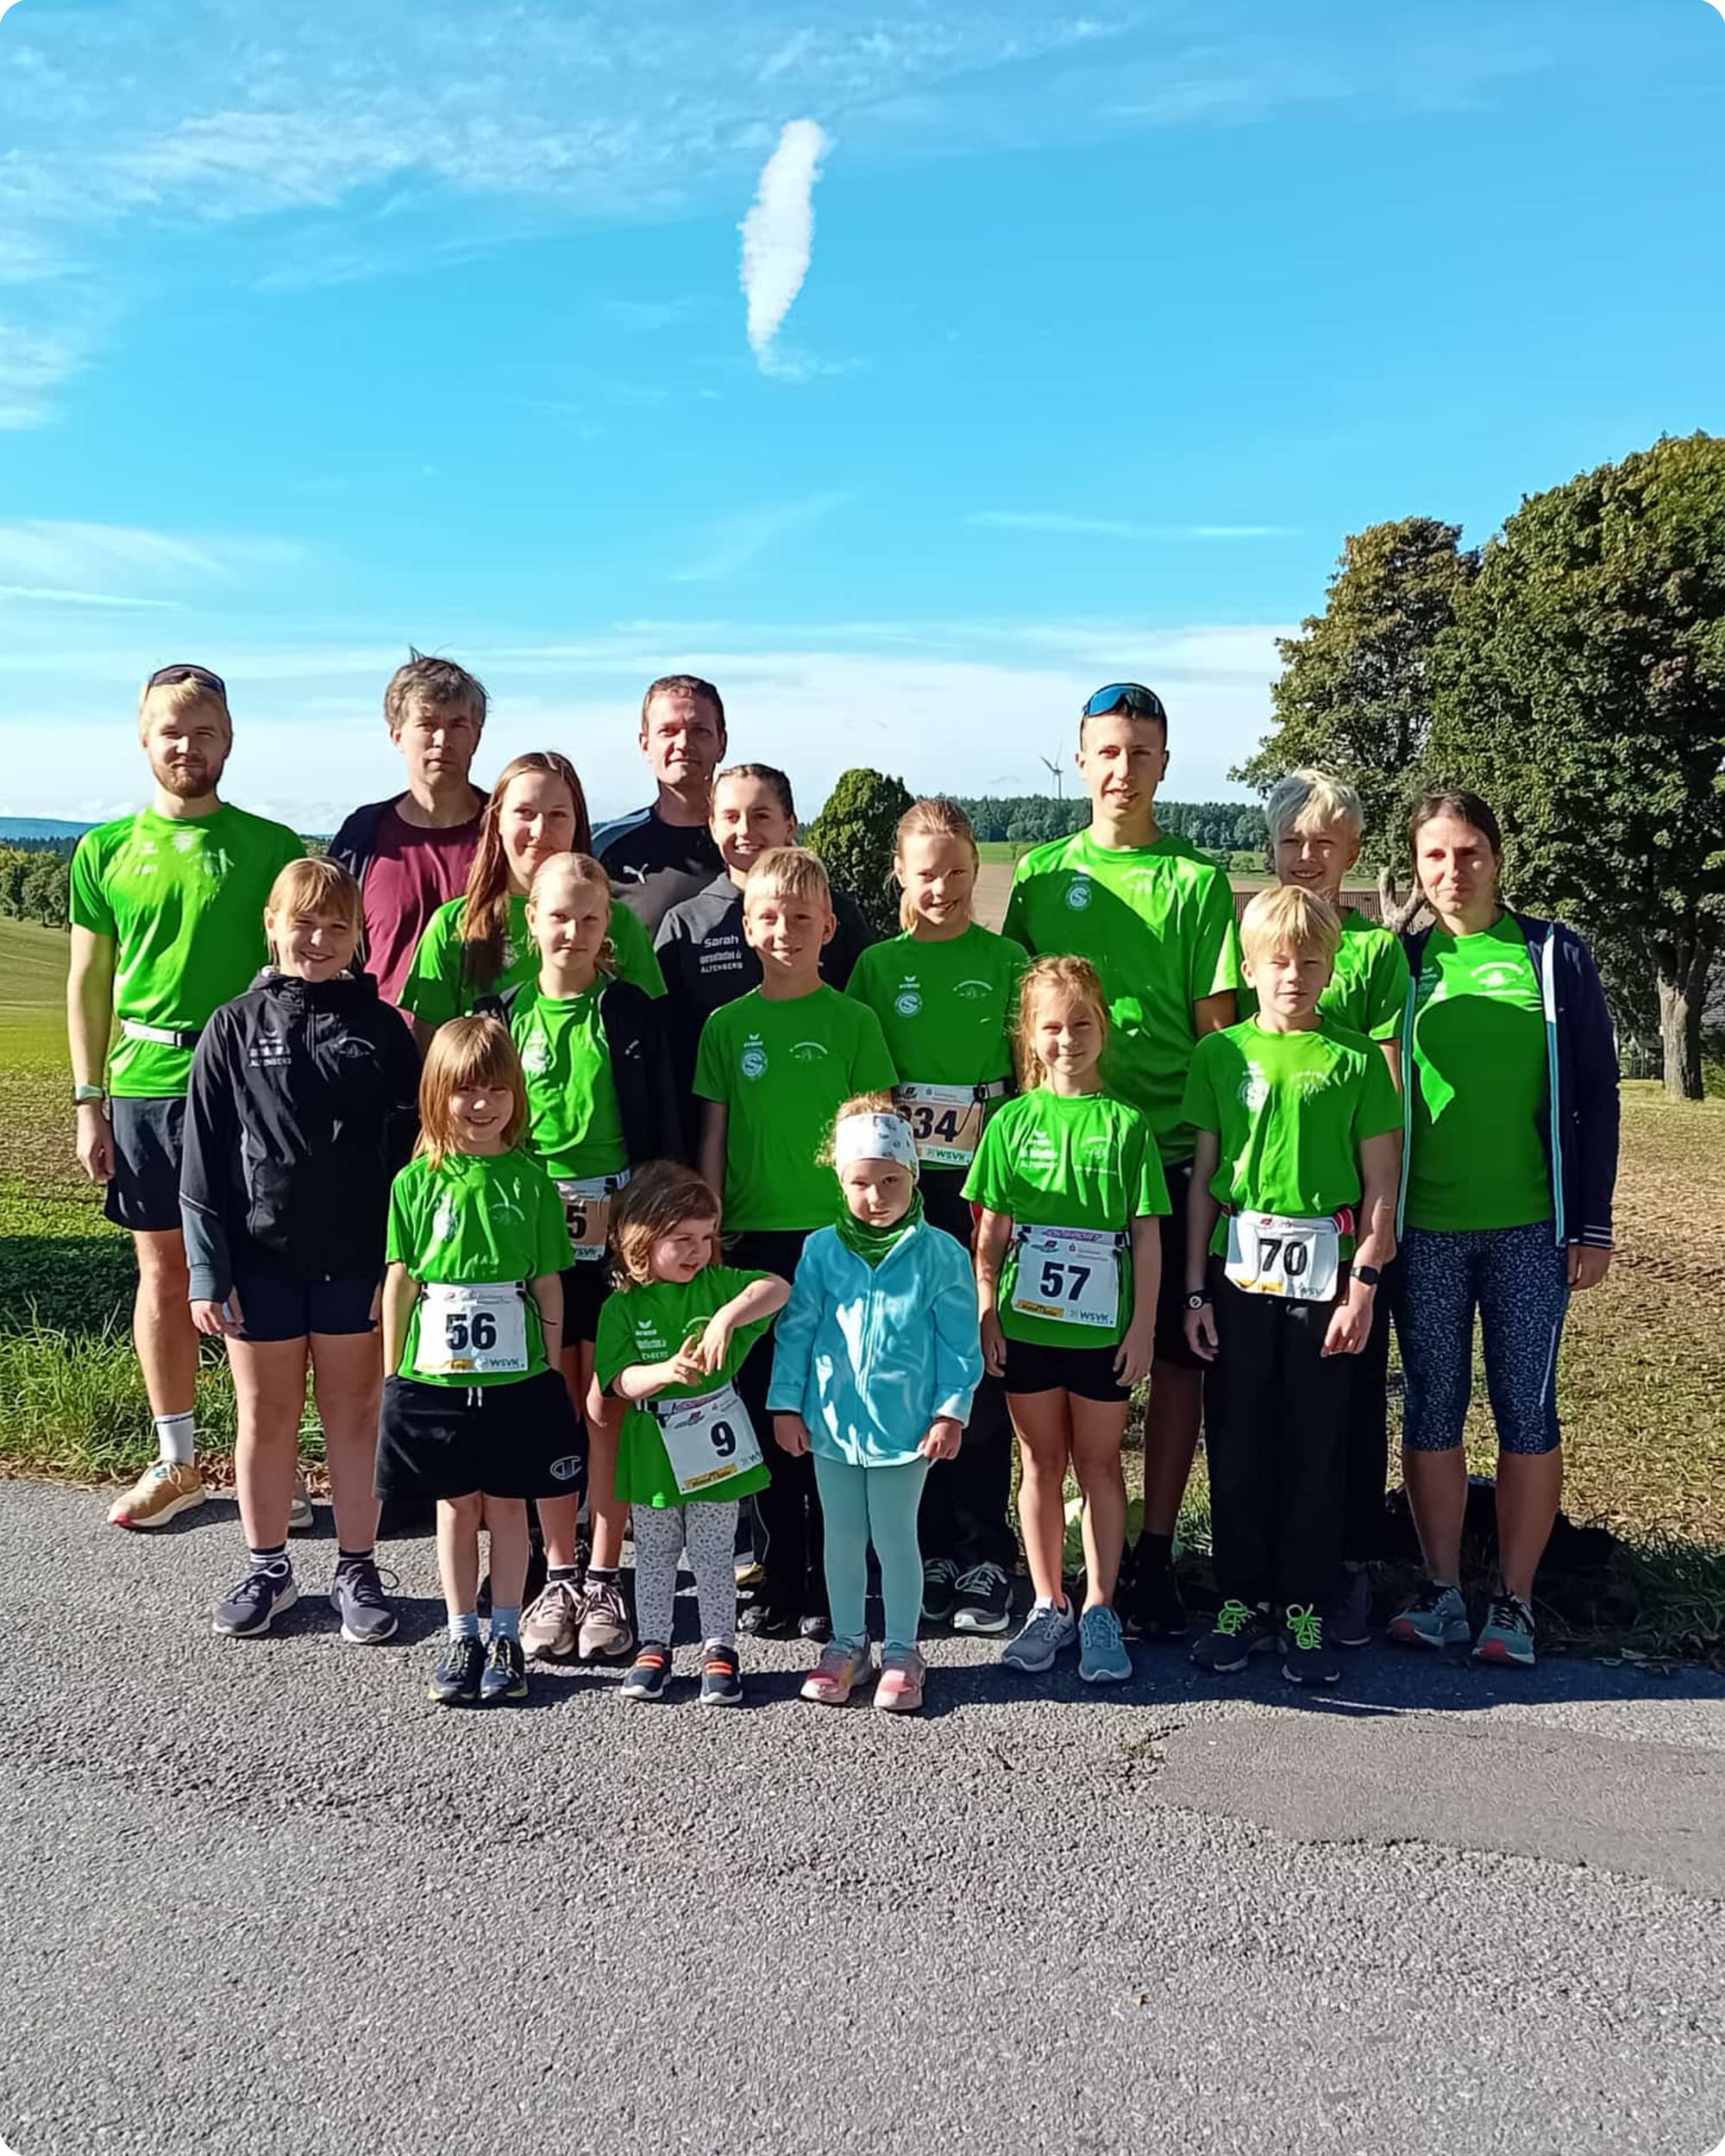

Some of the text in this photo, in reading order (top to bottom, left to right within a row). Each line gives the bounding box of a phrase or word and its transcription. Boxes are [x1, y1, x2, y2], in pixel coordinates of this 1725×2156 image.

[704, 934, 739, 948] Sarah
[567, 1205, 587, 1239] 5
[1259, 1238, 1308, 1276] 70
[1040, 1261, 1091, 1300] 57
[446, 1312, 497, 1351] 56
[711, 1420, 737, 1457] 9
